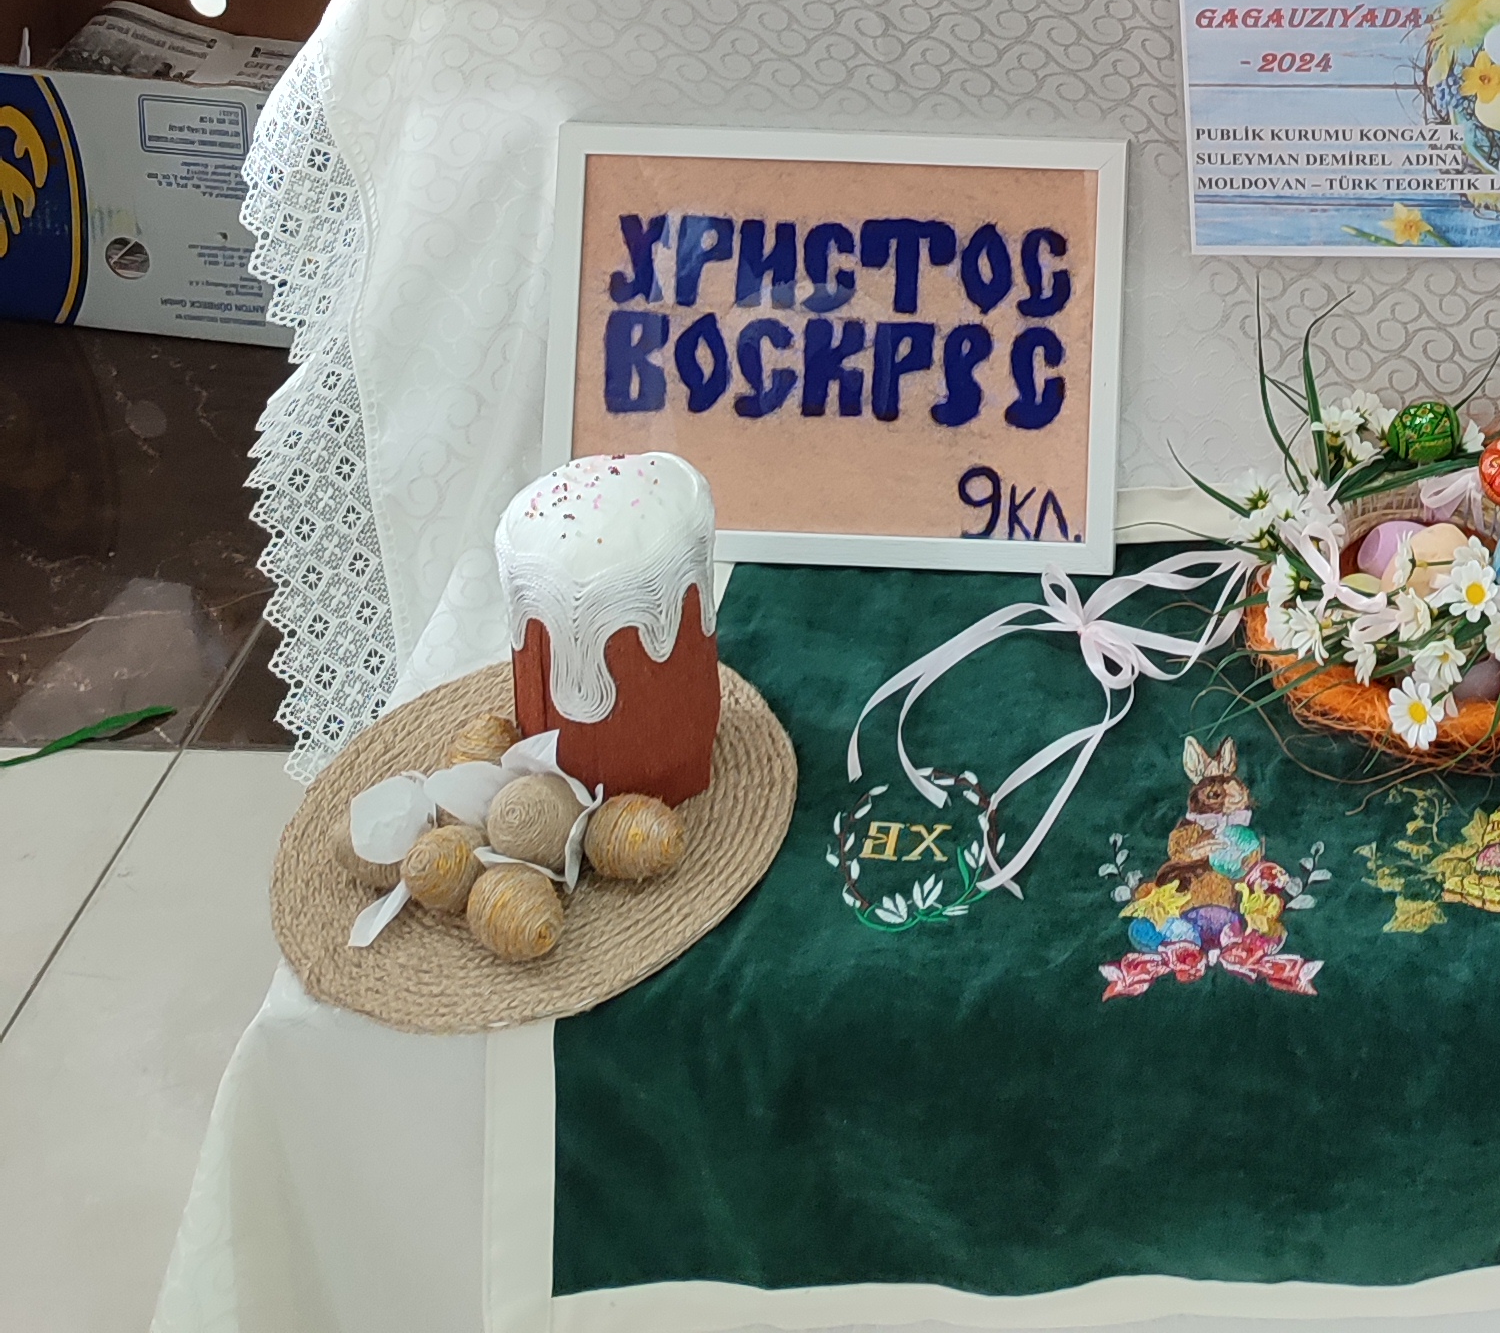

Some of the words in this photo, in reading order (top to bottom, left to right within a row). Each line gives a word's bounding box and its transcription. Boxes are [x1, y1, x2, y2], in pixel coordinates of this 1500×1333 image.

[1256, 51, 1333, 73] 2024
[1195, 125, 1265, 142] PUBLİK
[1270, 128, 1354, 142] KURUMU
[1359, 128, 1440, 142] KONGAZ
[1449, 128, 1464, 142] k.
[1195, 152, 1300, 166] SULEYMAN
[1305, 150, 1392, 166] DEMİREL
[1401, 153, 1461, 166] ADINA
[1197, 176, 1307, 190] MOLDOVAN
[1325, 175, 1378, 191] TÜRK
[1383, 178, 1480, 191] TEORETIK
[609, 213, 1072, 318] ХРИСТОС
